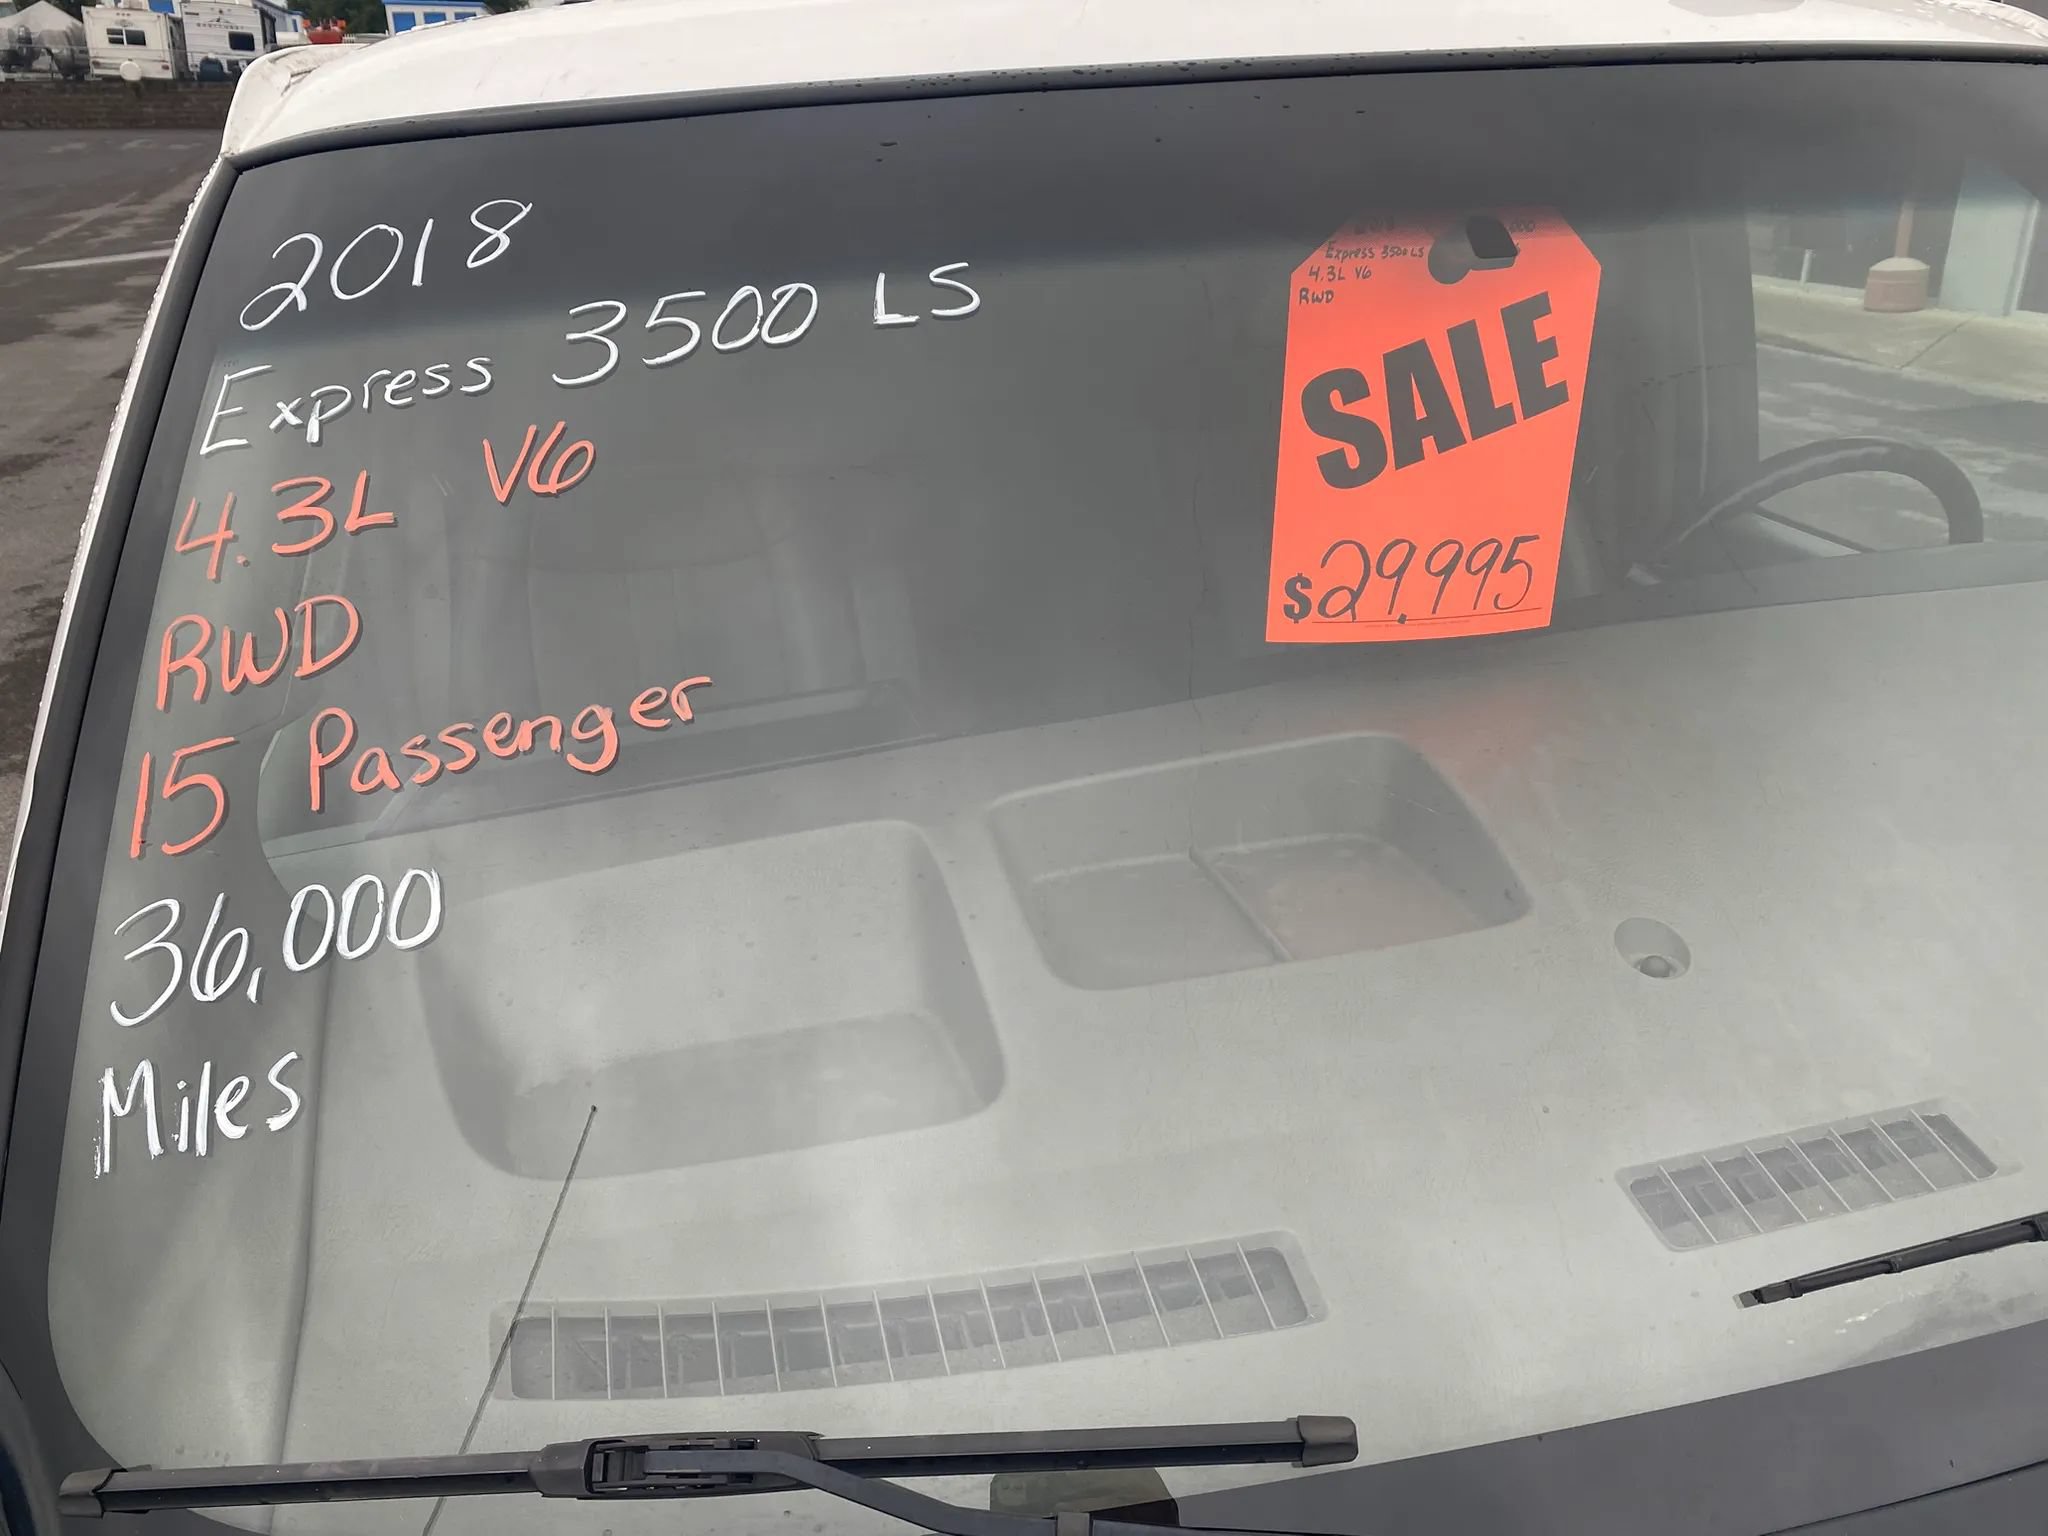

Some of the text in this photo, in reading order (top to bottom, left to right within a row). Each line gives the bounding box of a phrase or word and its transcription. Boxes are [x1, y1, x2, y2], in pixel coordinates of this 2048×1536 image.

[239, 199, 534, 332] 2018
[1299, 287, 1334, 305] RWD
[1325, 240, 1375, 263] Express
[1381, 245, 1407, 259] 3500
[1355, 265, 1372, 280] V6
[199, 261, 983, 456] Express 3500 LS
[1301, 291, 1570, 490] SALE
[174, 420, 596, 580] 4.3L V6
[156, 594, 360, 711] RWD
[130, 675, 713, 859] 15 Passenger
[110, 867, 443, 1028] 36,000
[94, 1051, 301, 1180] Miles
